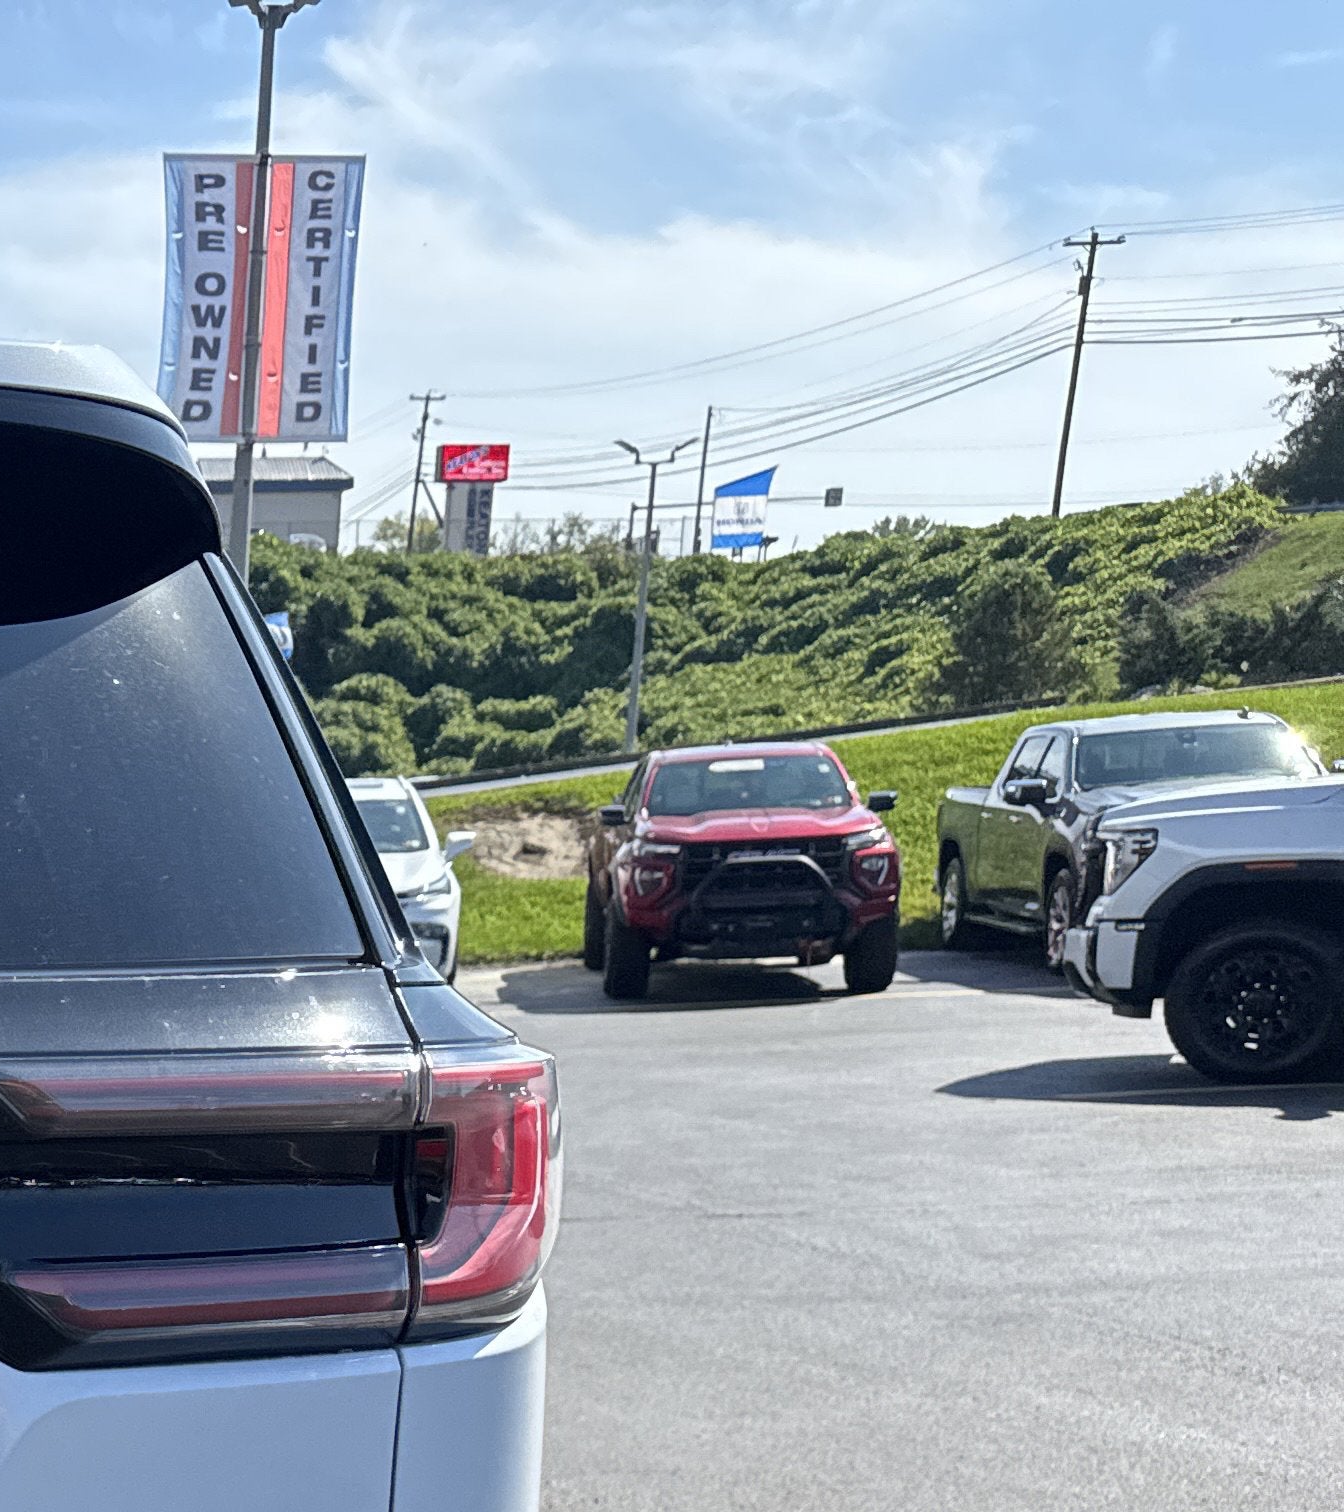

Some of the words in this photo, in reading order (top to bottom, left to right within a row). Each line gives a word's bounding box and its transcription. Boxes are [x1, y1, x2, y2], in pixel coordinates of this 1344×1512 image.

[194, 173, 226, 252] PRE
[181, 271, 227, 422] OWNED
[295, 169, 336, 422] CERTIFIED
